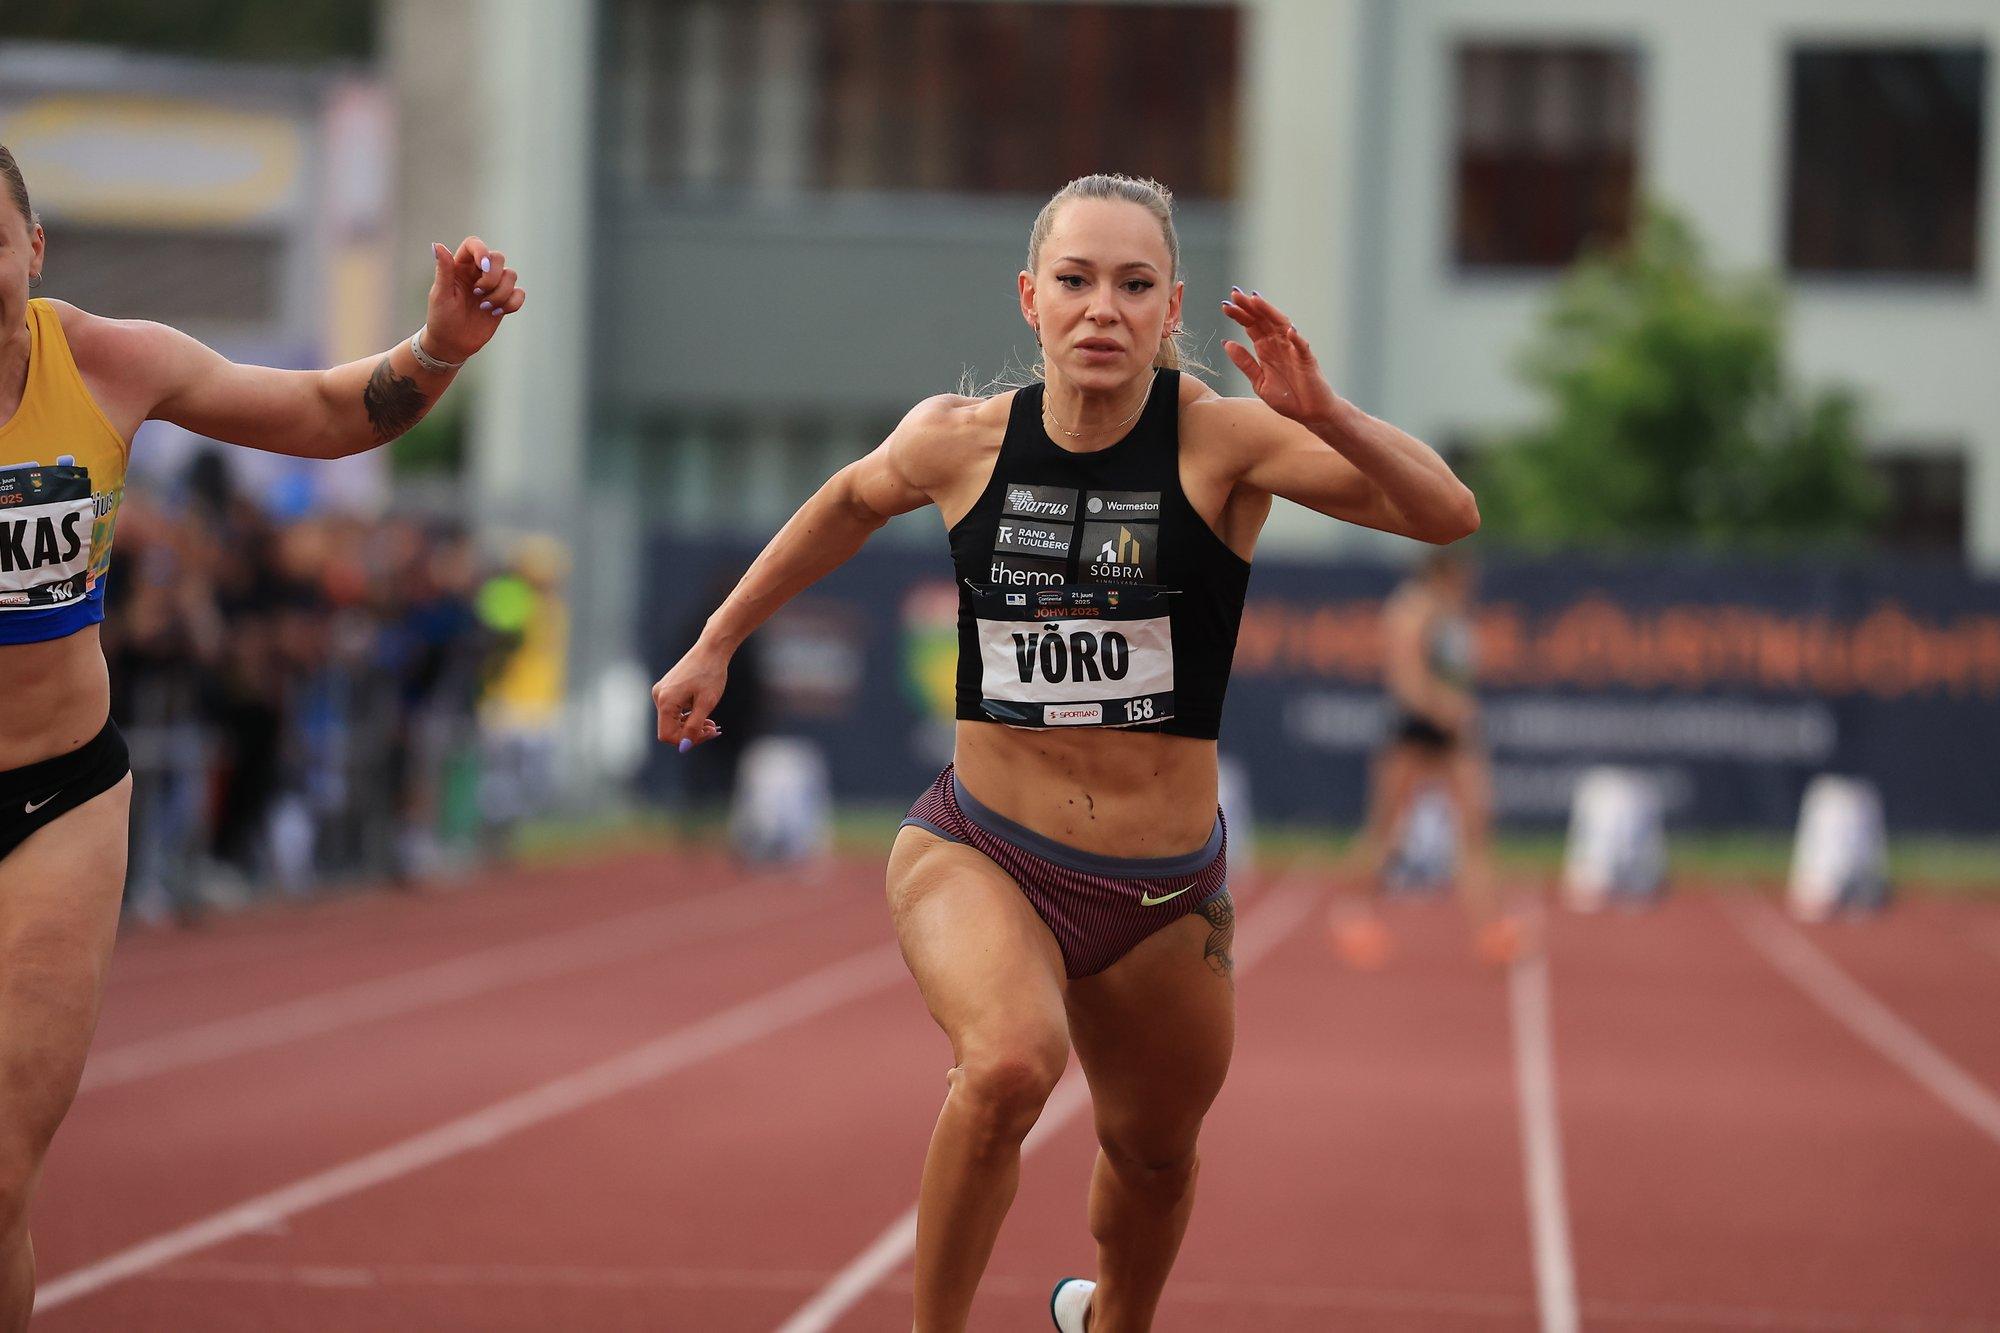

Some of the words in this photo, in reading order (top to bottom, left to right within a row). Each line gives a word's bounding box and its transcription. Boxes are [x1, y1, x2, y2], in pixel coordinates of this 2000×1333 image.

[1018, 496, 1069, 516] barrus
[1106, 501, 1159, 511] Warmeston
[0, 511, 81, 573] KAS
[1018, 528, 1047, 539] RAND
[1048, 532, 1056, 540] &
[1017, 536, 1069, 550] TUULBERG
[990, 561, 1065, 586] themo
[1090, 562, 1144, 579] SÕBRA
[1070, 607, 1100, 616] 2025
[1011, 623, 1129, 684] VÕRO
[1059, 710, 1098, 719] SPORTLAND
[1123, 698, 1154, 722] 158
